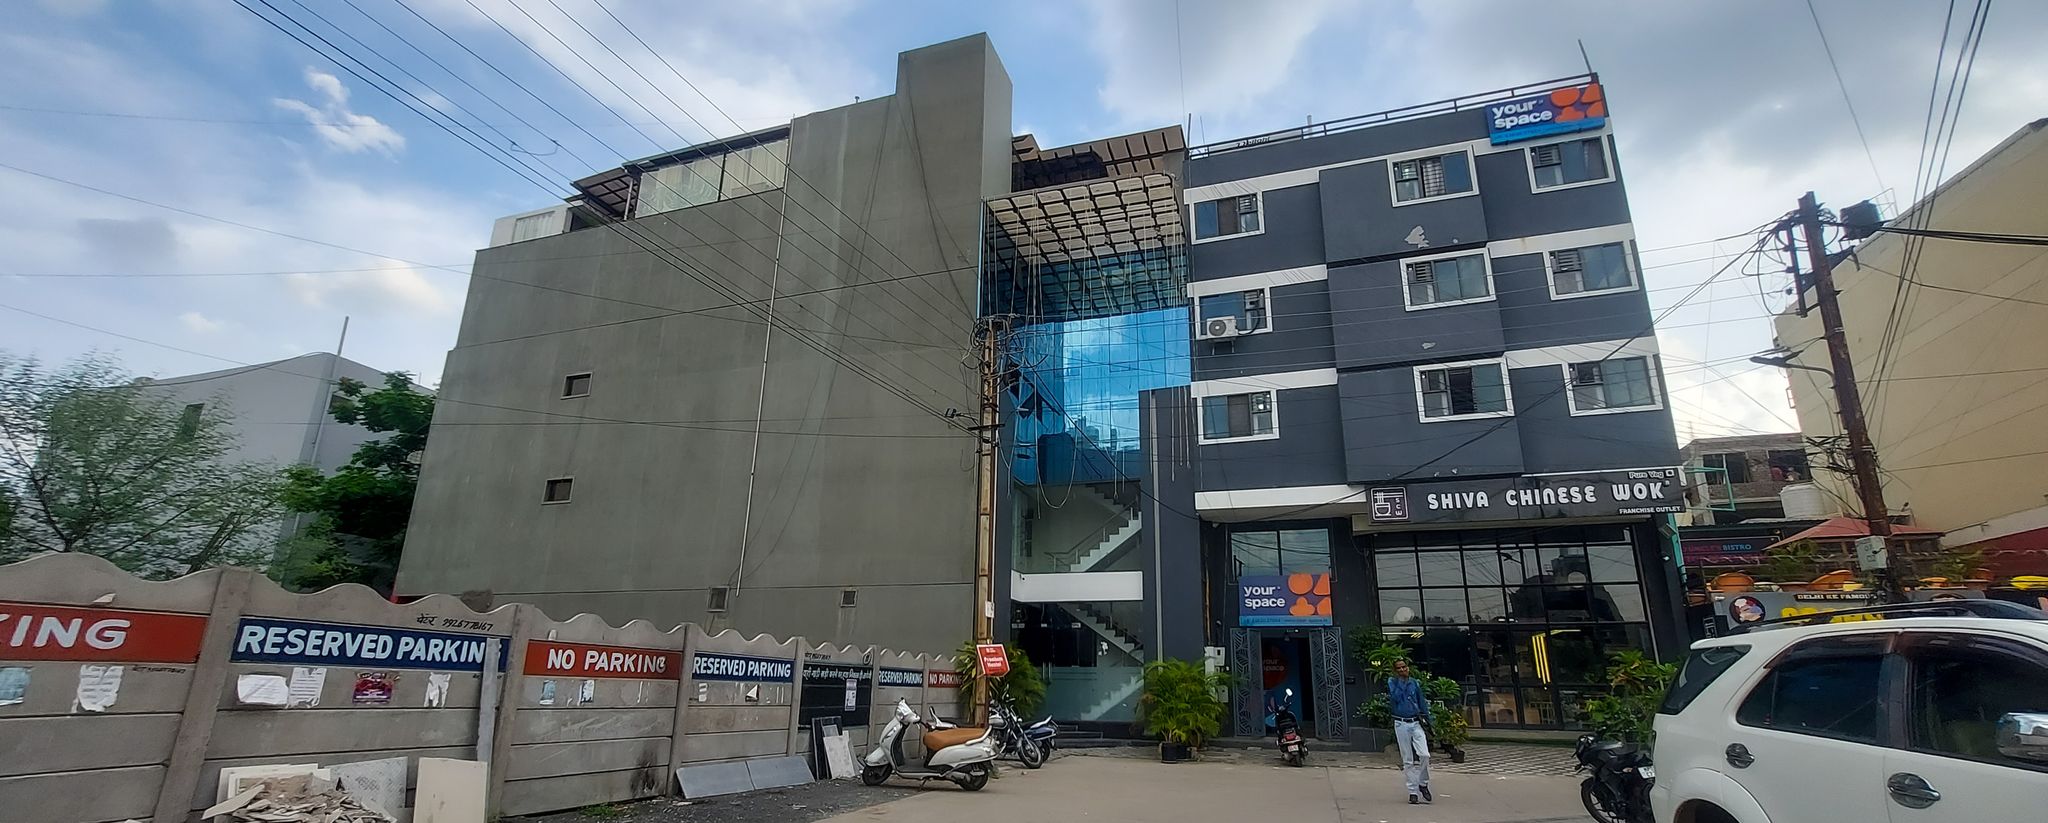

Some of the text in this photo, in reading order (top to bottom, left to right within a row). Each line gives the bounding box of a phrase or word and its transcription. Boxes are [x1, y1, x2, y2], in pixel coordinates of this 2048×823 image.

[1492, 101, 1538, 119] your
[1494, 110, 1553, 129] space
[1427, 482, 1665, 510] SHIVA CHINESE WOK
[1655, 505, 1681, 513] OUTLET
[1244, 586, 1276, 597] your
[1245, 597, 1286, 609] space
[237, 625, 502, 664] RESERVED PARKIN
[547, 648, 576, 670] NO
[692, 656, 791, 678] RESERVED PARKING
[879, 671, 903, 684] RESERVED
[903, 673, 923, 684] PARKING
[929, 673, 938, 684] NO
